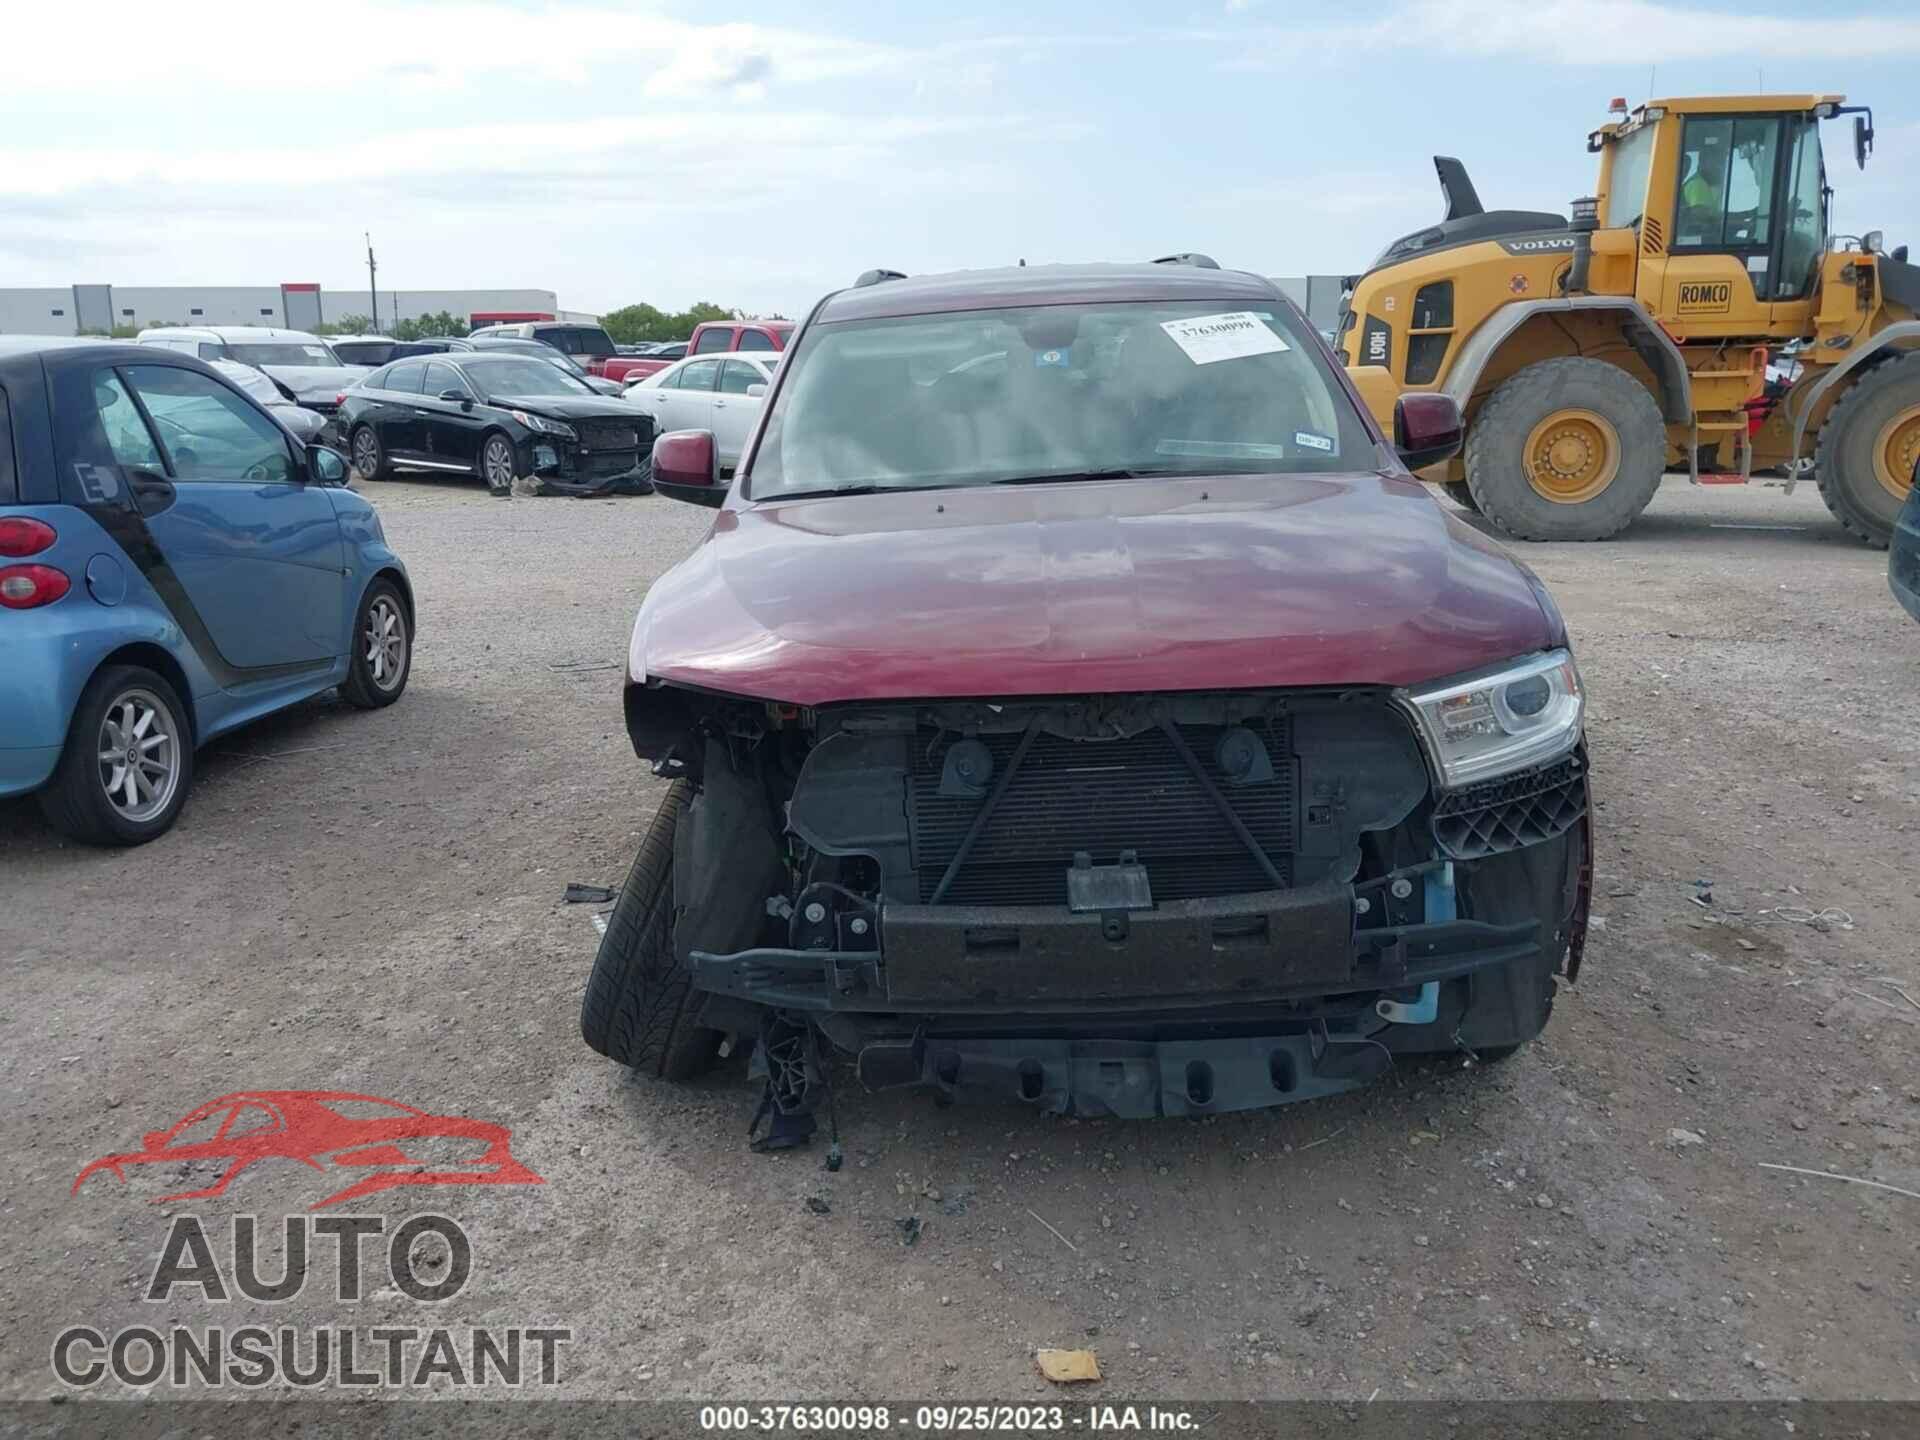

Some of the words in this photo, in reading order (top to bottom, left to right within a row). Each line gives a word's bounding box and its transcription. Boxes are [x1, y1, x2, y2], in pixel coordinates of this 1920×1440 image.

[1509, 239, 1576, 251] VOLVO
[1681, 284, 1728, 304] ROMCO
[1180, 320, 1255, 337] 37630098
[1370, 331, 1386, 360] L90H
